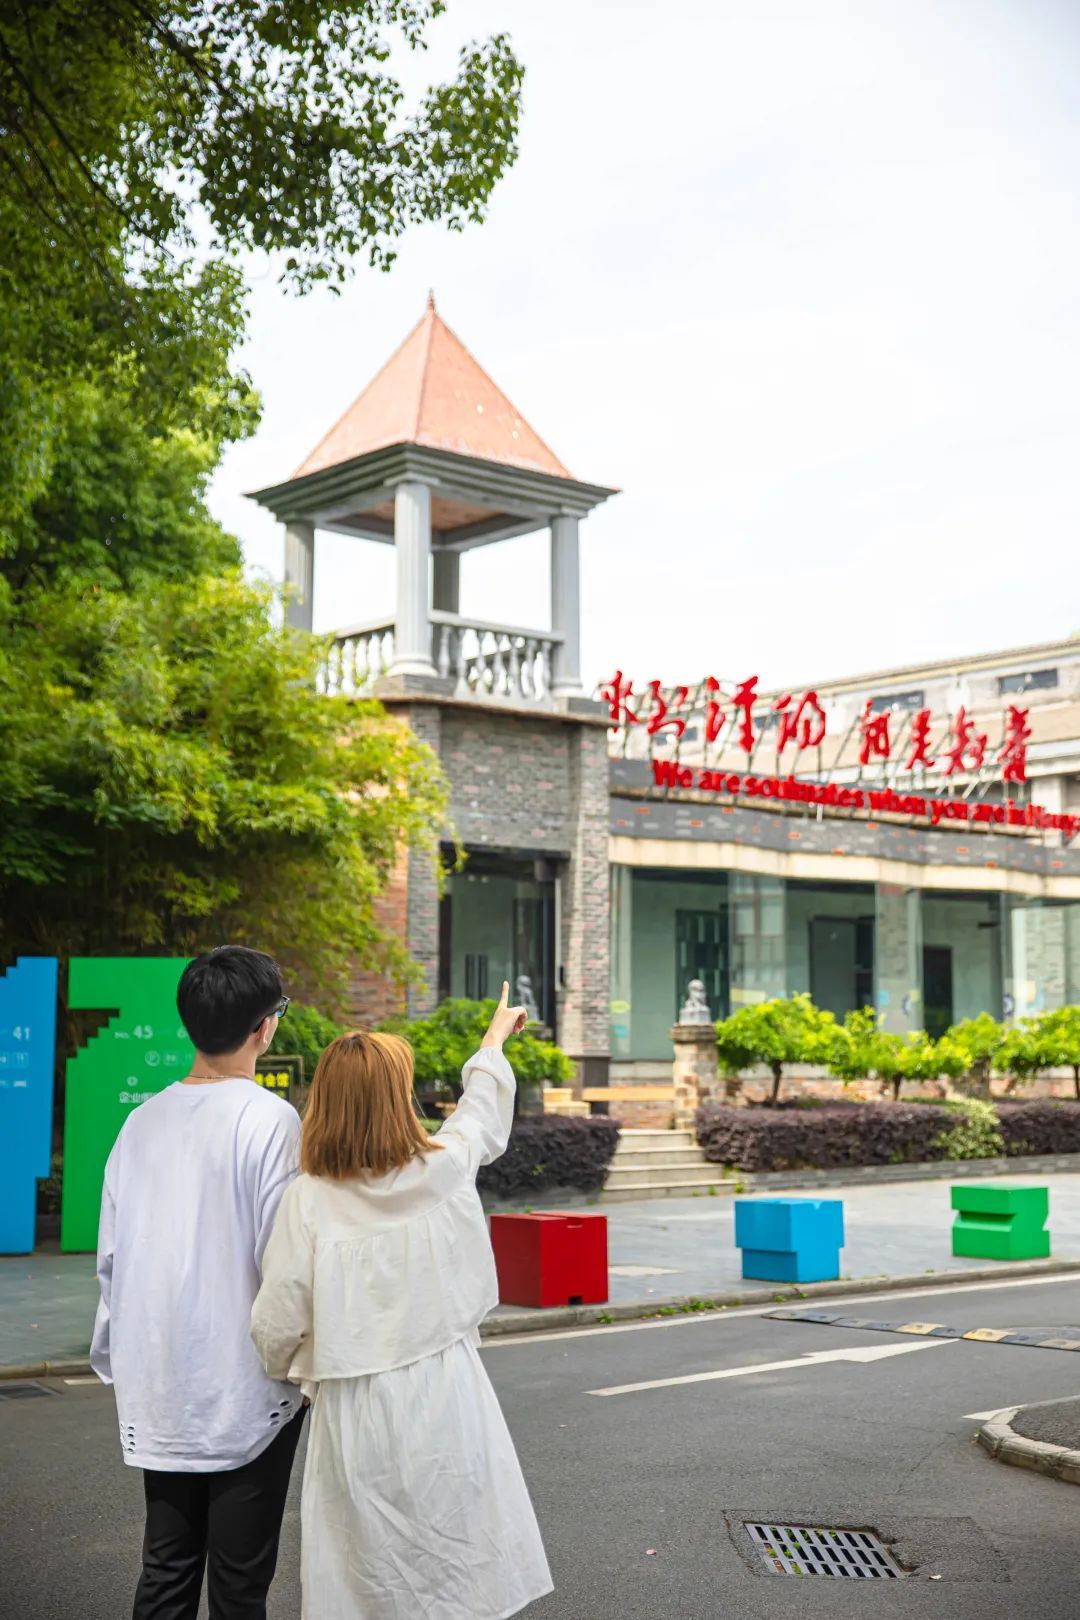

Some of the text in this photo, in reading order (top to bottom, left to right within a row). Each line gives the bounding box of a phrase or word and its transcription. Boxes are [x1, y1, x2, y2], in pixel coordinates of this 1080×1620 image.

[653, 759, 694, 788] We
[699, 768, 741, 795] are
[742, 773, 865, 808] soulmates
[868, 786, 926, 817] when
[930, 799, 968, 826] you
[971, 803, 1006, 824] are
[133, 1024, 154, 1041] 45
